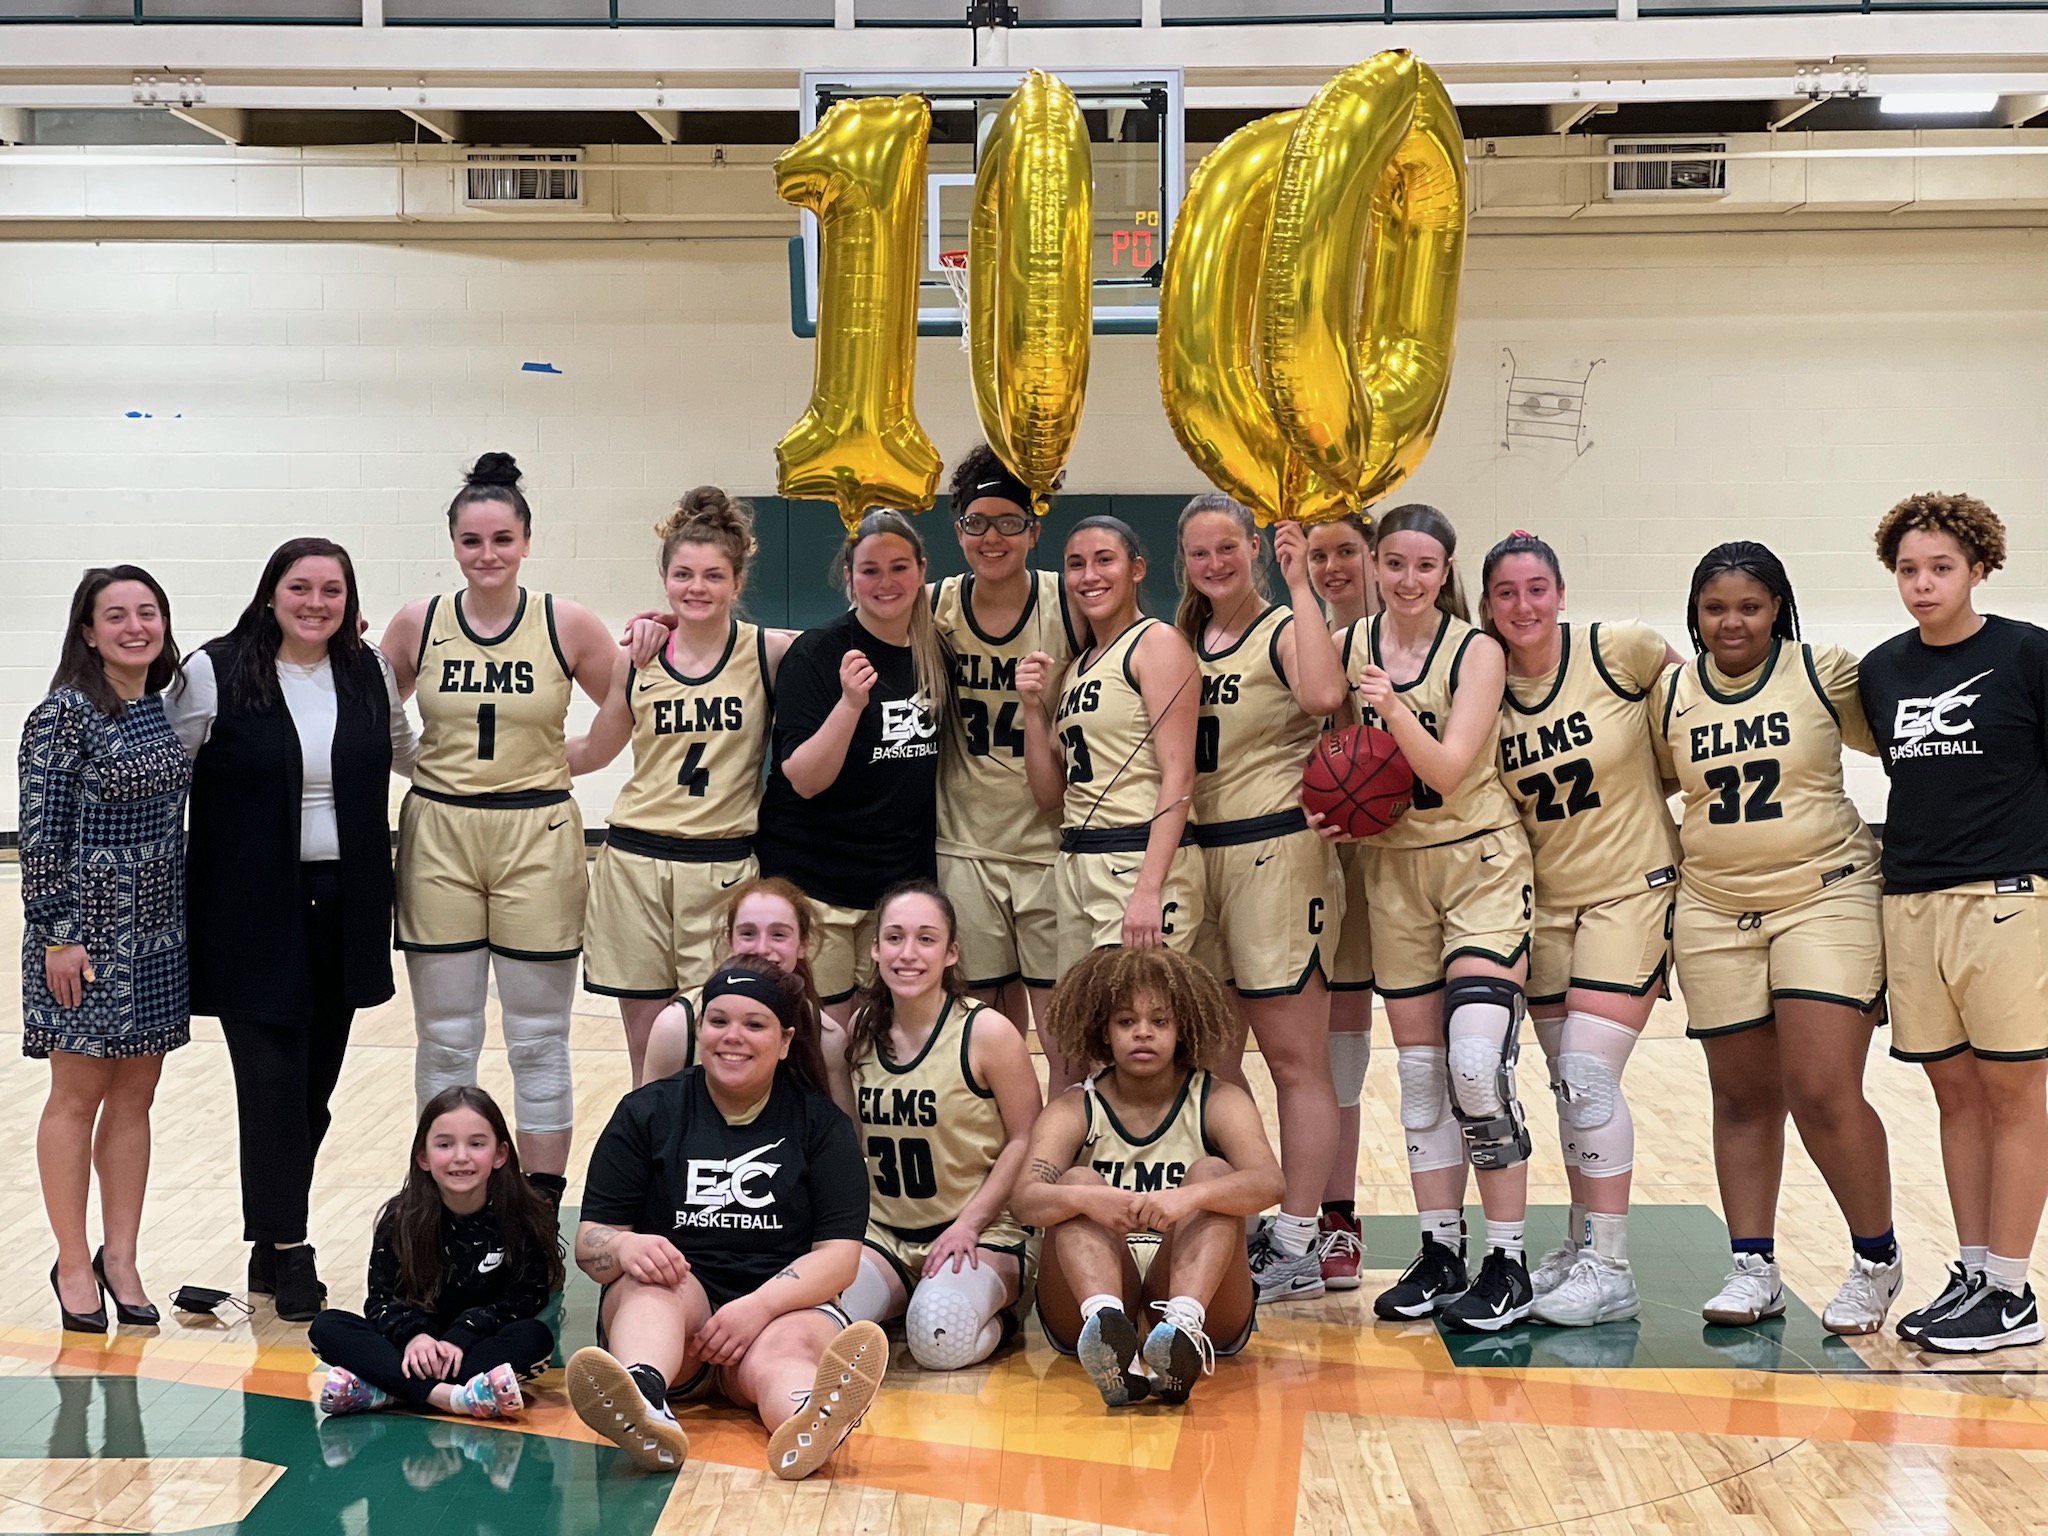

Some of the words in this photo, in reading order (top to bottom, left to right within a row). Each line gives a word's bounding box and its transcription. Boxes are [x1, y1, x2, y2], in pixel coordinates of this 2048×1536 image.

[439, 660, 534, 694] ELMS
[955, 653, 1026, 691] ELM
[1200, 673, 1241, 706] MS
[653, 696, 742, 735] ELMS
[1056, 679, 1101, 724] LMS
[1893, 688, 1981, 739] EC
[476, 703, 496, 760] 1
[959, 697, 1025, 758] 34
[1361, 706, 1438, 742] ES
[1500, 711, 1593, 773] ELMS
[1690, 711, 1790, 763] ELMS
[677, 742, 709, 797] 4
[872, 742, 939, 760] BASKETBALL
[1889, 740, 1984, 760] BASKETBALL
[1516, 758, 1602, 822] 22
[1703, 758, 1783, 825] 32
[1161, 901, 1178, 935] C
[1308, 897, 1325, 935] C
[858, 1087, 938, 1127] ELMS
[684, 1156, 782, 1209] EC
[867, 1136, 938, 1199] 30
[675, 1210, 784, 1230] BASKETBALL
